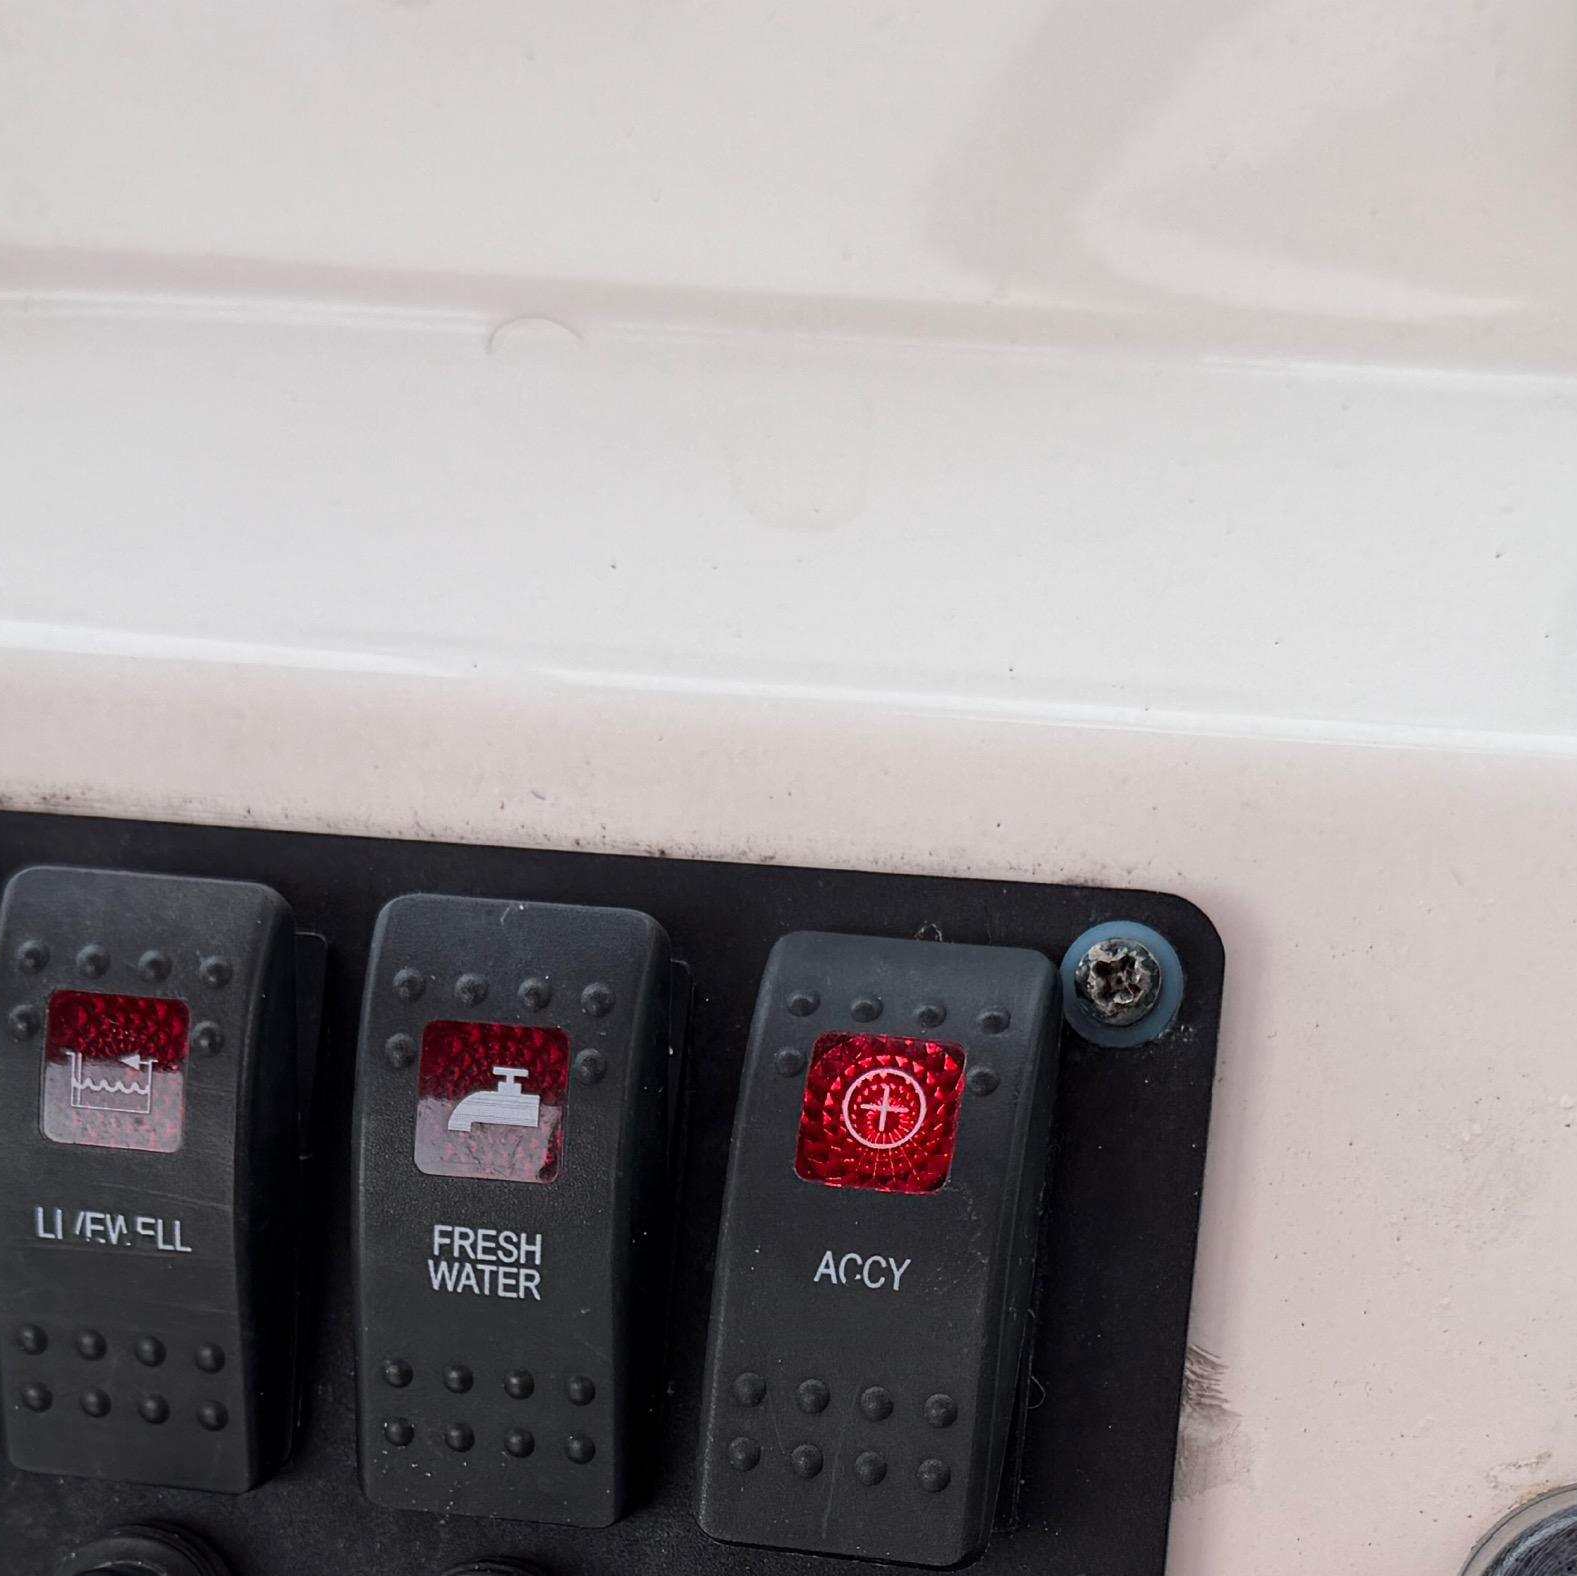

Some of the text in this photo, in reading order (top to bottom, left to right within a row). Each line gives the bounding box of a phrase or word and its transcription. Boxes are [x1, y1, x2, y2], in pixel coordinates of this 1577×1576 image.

[432, 1224, 542, 1265] FRESH
[427, 1259, 542, 1300] WATER
[813, 1250, 911, 1291] ACCY
